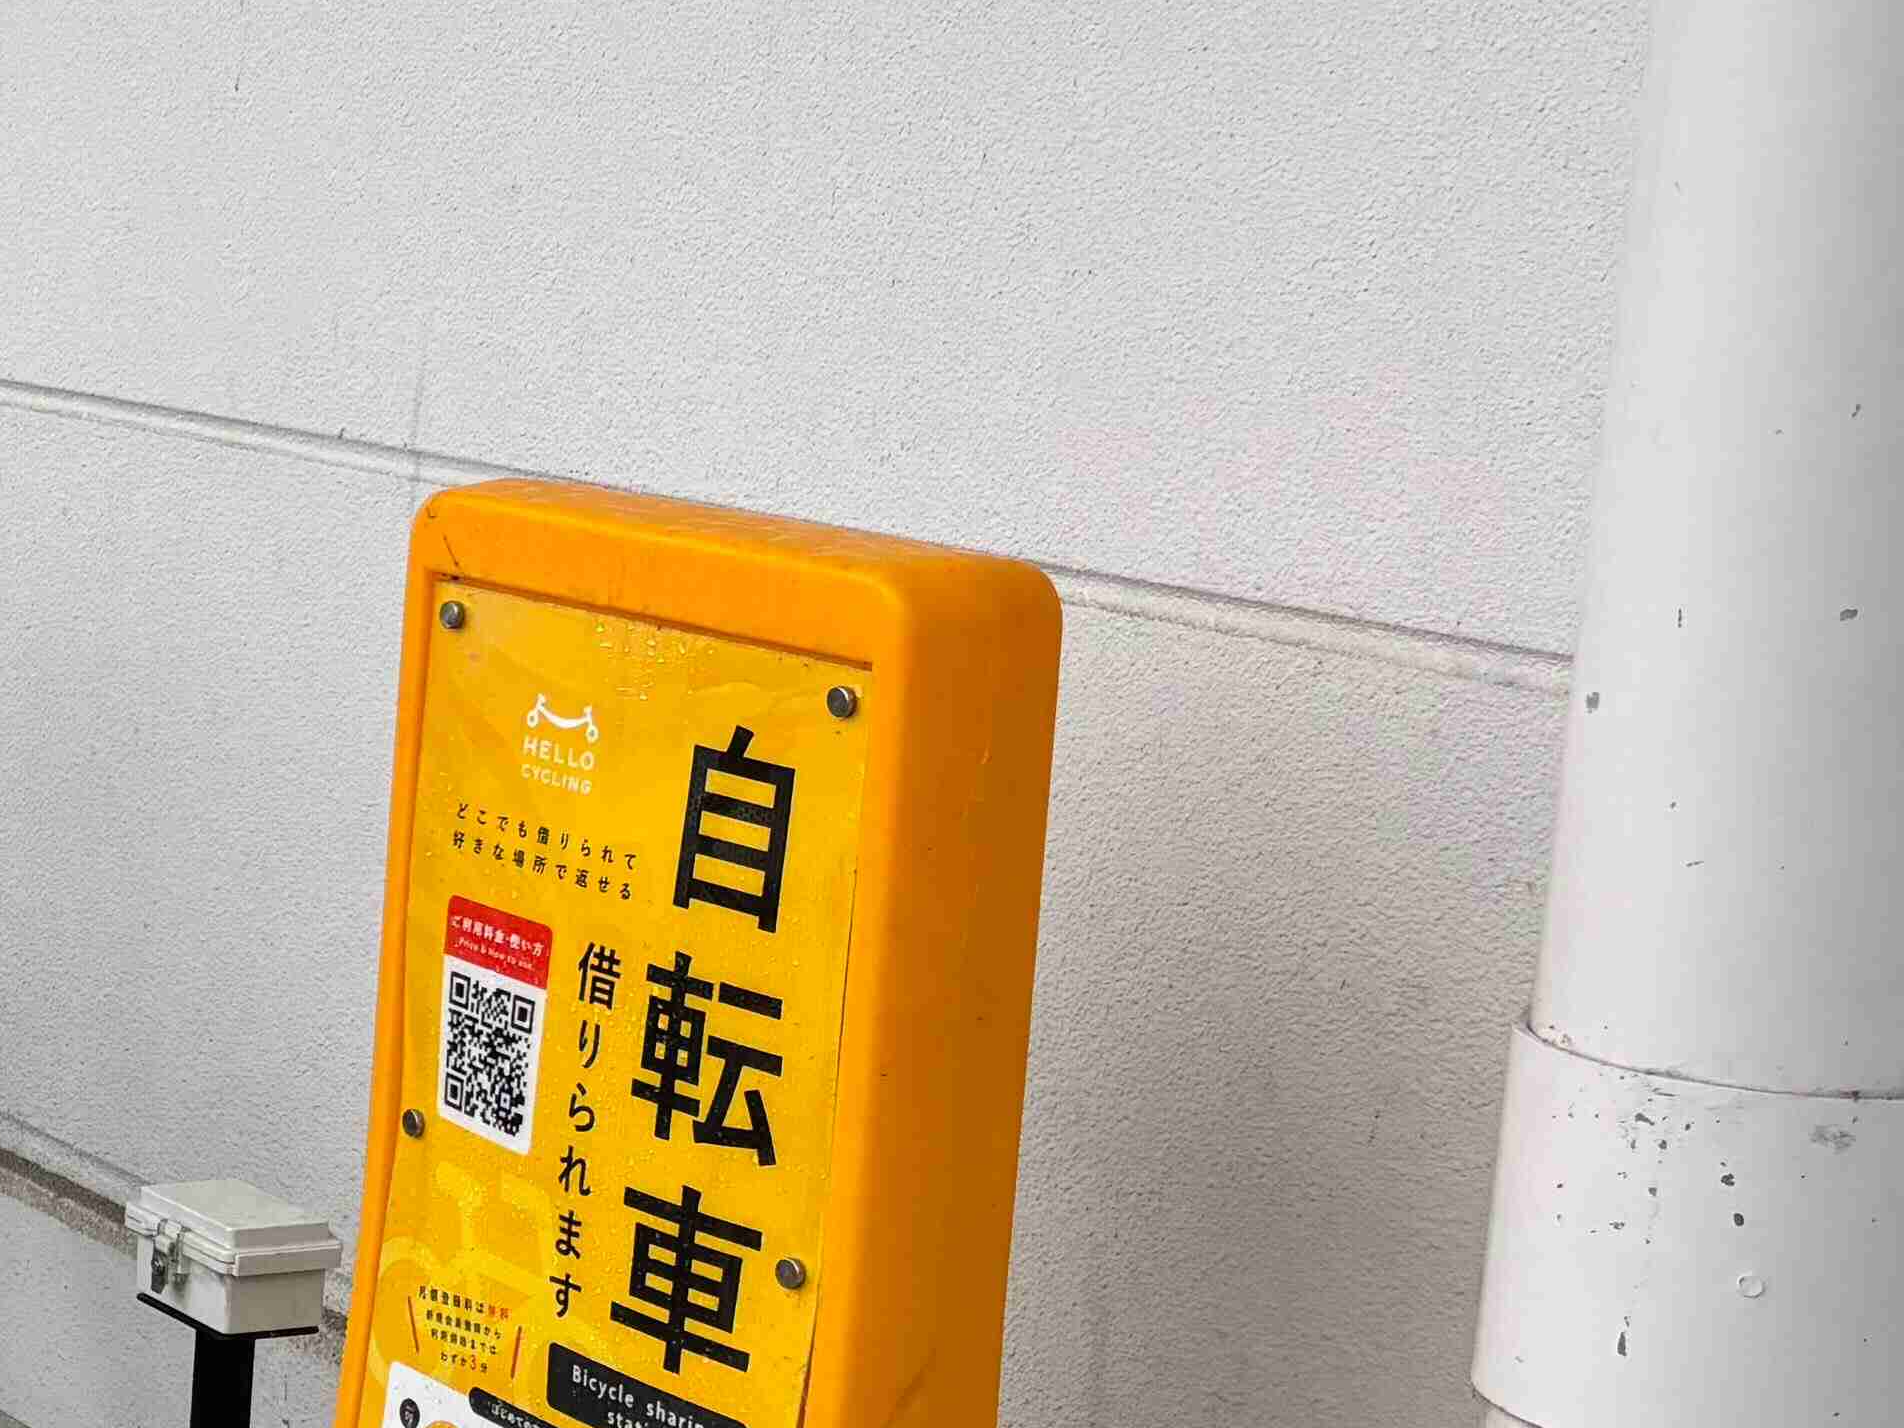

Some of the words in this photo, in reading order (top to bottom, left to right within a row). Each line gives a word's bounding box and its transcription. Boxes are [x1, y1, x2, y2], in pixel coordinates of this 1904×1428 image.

[520, 763, 592, 795] CYCLING
[522, 735, 596, 771] HELLO
[452, 829, 632, 900] 好きな場所で返せる
[456, 802, 637, 870] どこでも借りられて
[609, 724, 795, 1374] 自転車
[548, 940, 622, 1318] 借りられます
[572, 1364, 634, 1408] Bicycle
